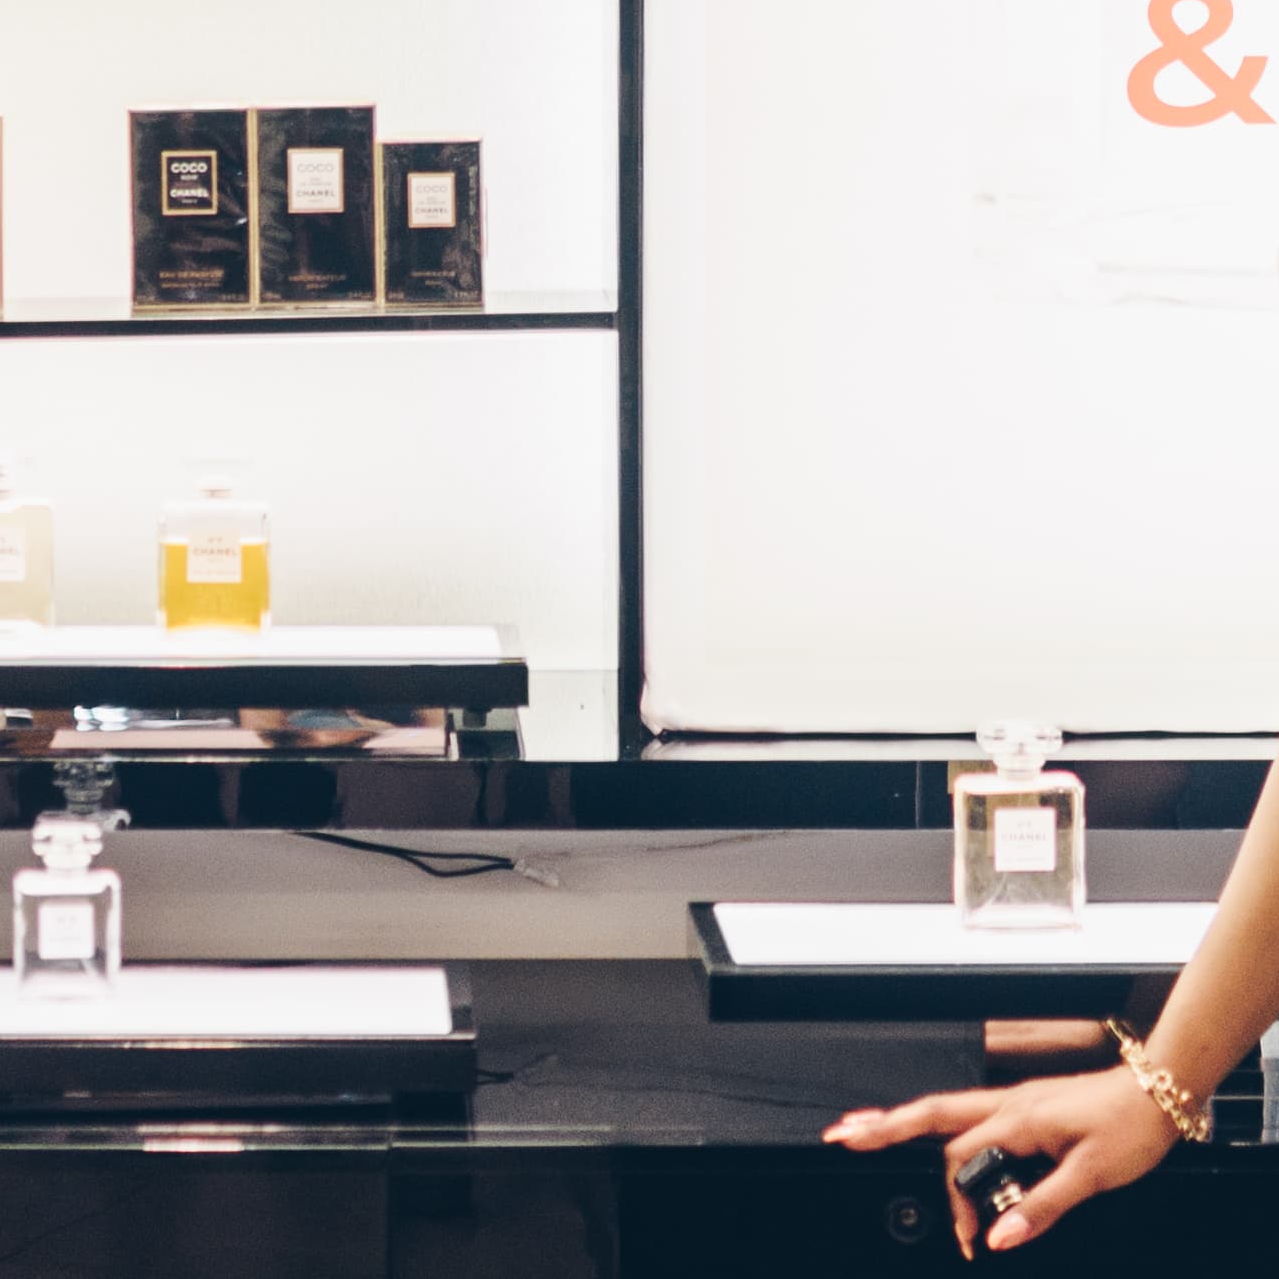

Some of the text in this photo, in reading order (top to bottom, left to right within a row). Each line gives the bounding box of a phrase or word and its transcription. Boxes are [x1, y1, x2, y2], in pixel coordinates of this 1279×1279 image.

[170, 162, 208, 173] COCO
[296, 162, 334, 172] COCO
[169, 188, 210, 198] CHANEL
[296, 189, 336, 198] CHANEL
[416, 185, 448, 193] COCO
[414, 207, 449, 215] CHANEL
